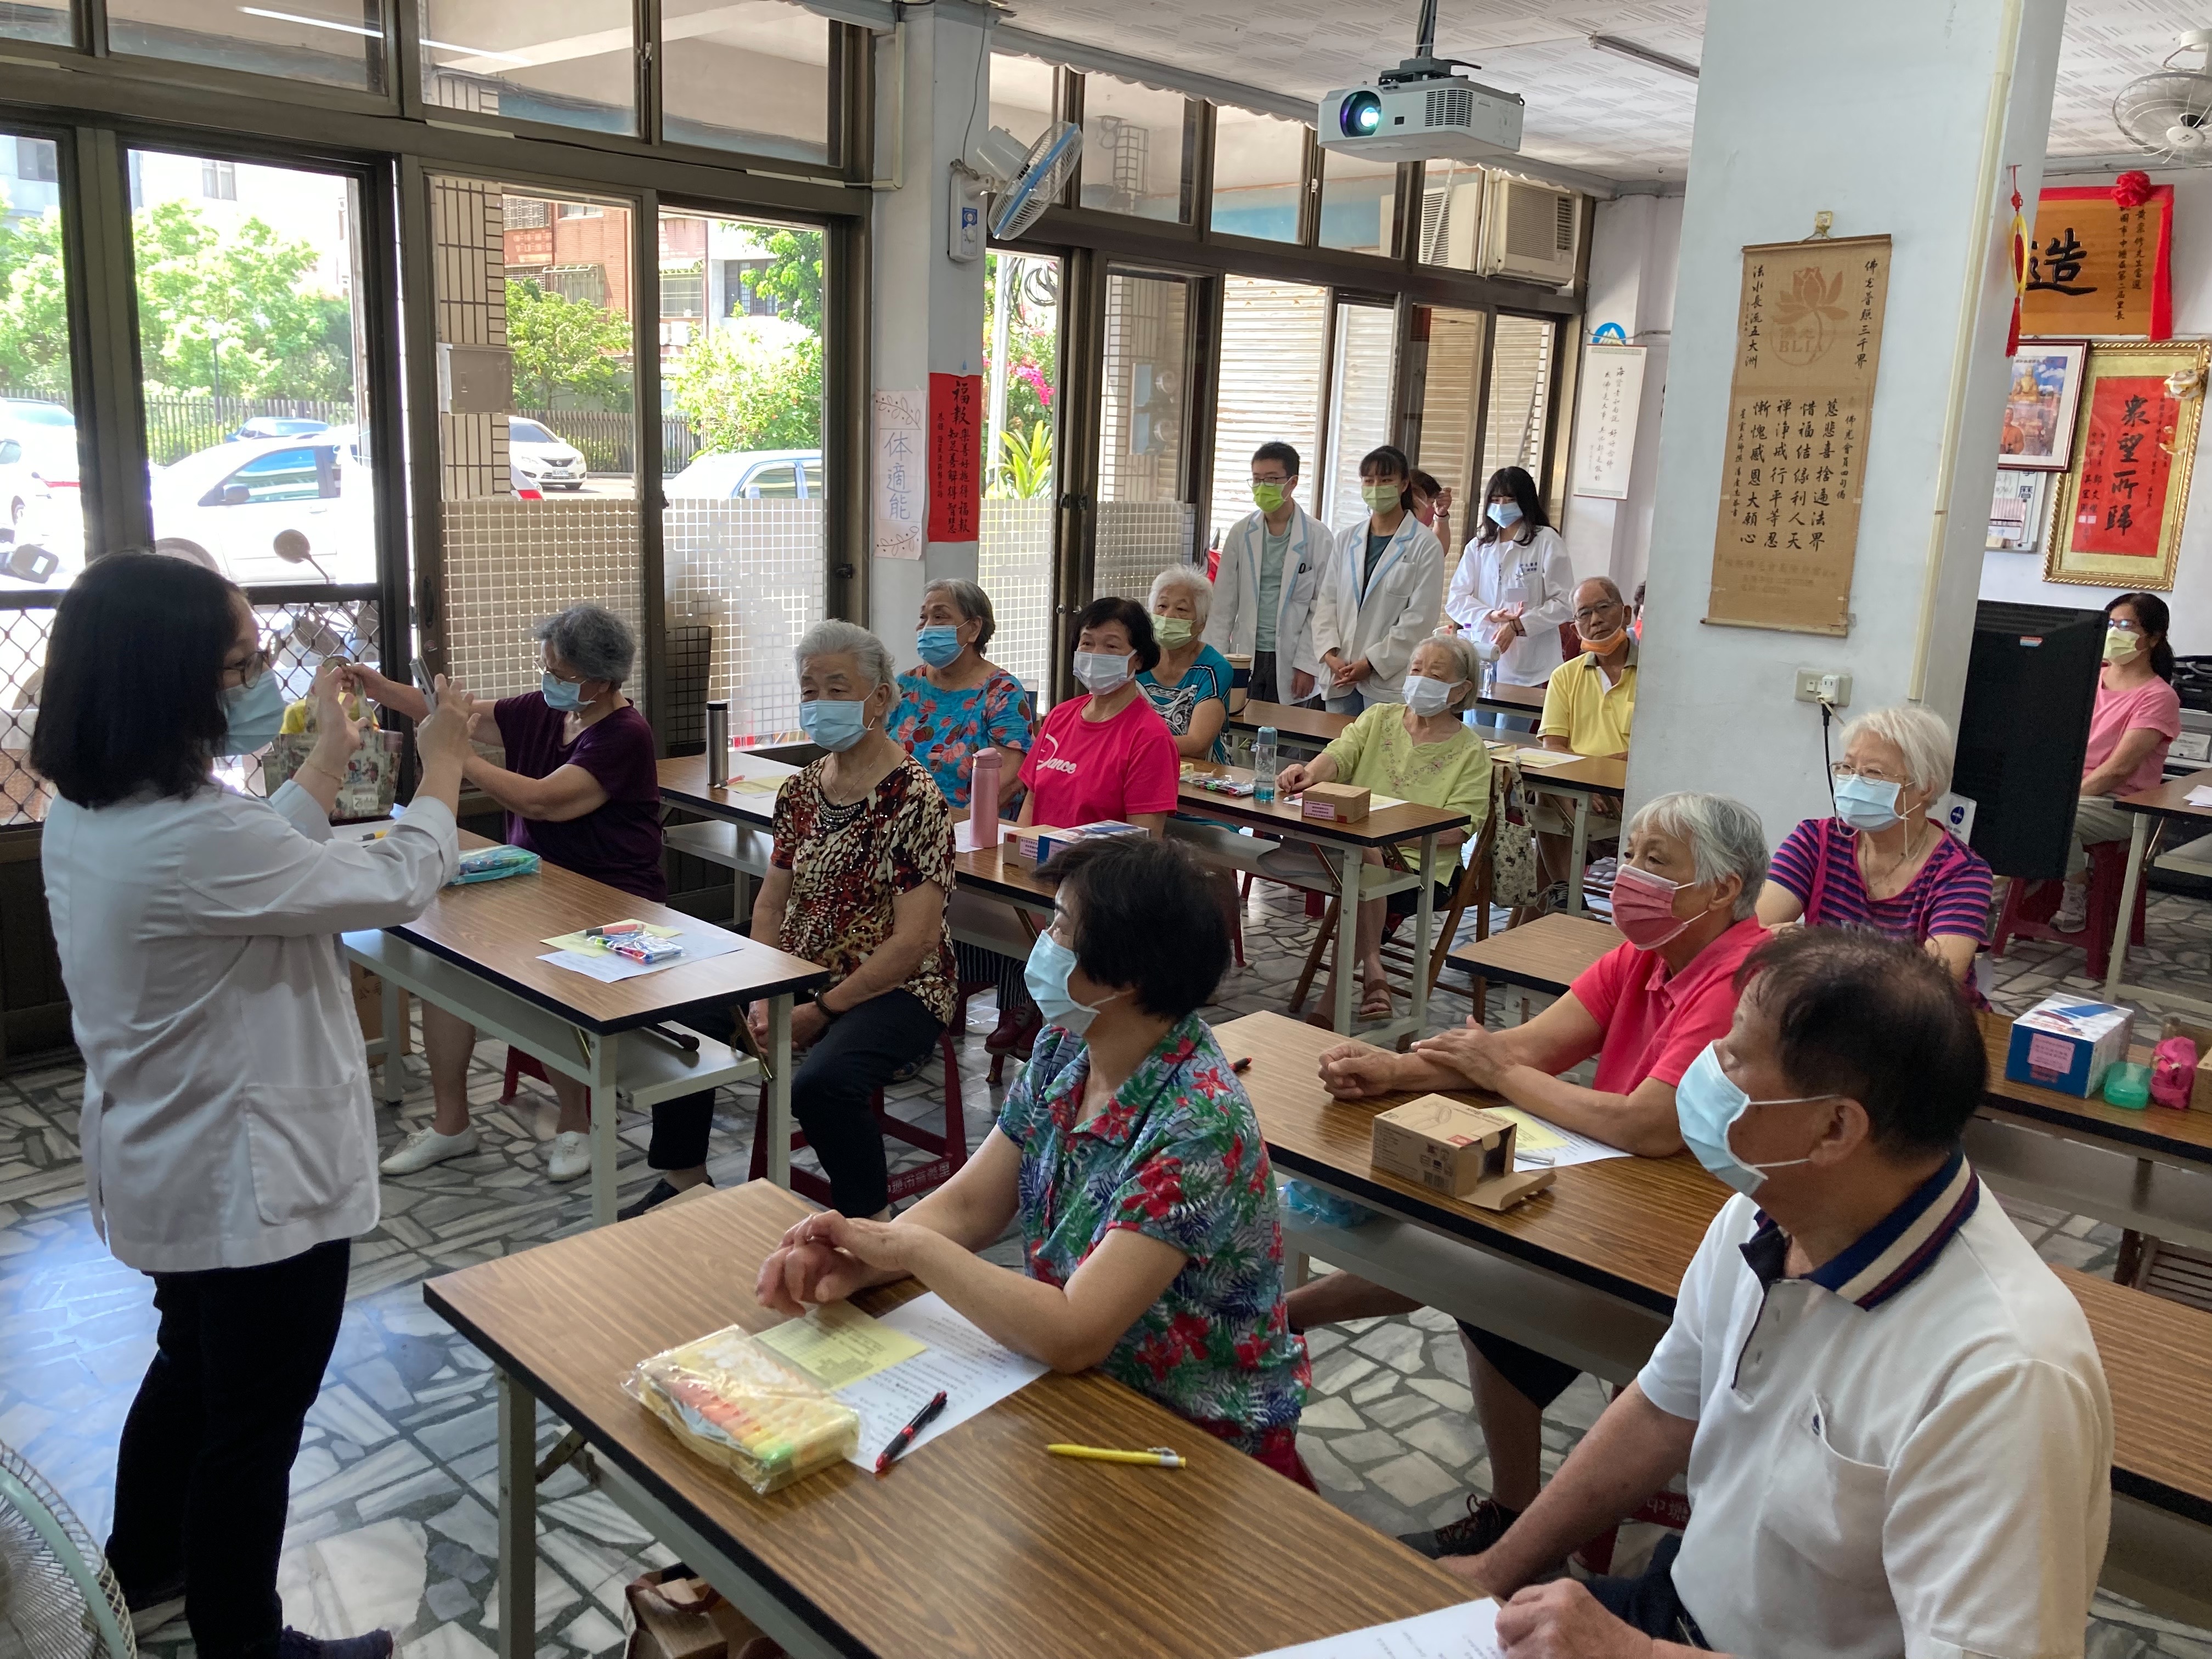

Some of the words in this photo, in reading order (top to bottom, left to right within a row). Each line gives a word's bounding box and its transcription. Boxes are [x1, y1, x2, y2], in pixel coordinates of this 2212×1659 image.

[1745, 265, 1764, 369] 法水長流五大洲
[1855, 258, 1877, 369] 佛光普照三千界
[2025, 228, 2097, 295] 造
[884, 431, 912, 520] 体適能
[1740, 401, 1771, 544] 慚愧感恩大願心
[1764, 400, 1791, 548] 禪淨戒行平等忍
[1787, 401, 1817, 550] 惜福結緣利人天
[1809, 398, 1838, 551] 慈悲喜捨遍法界
[1036, 733, 1076, 774] Dance
